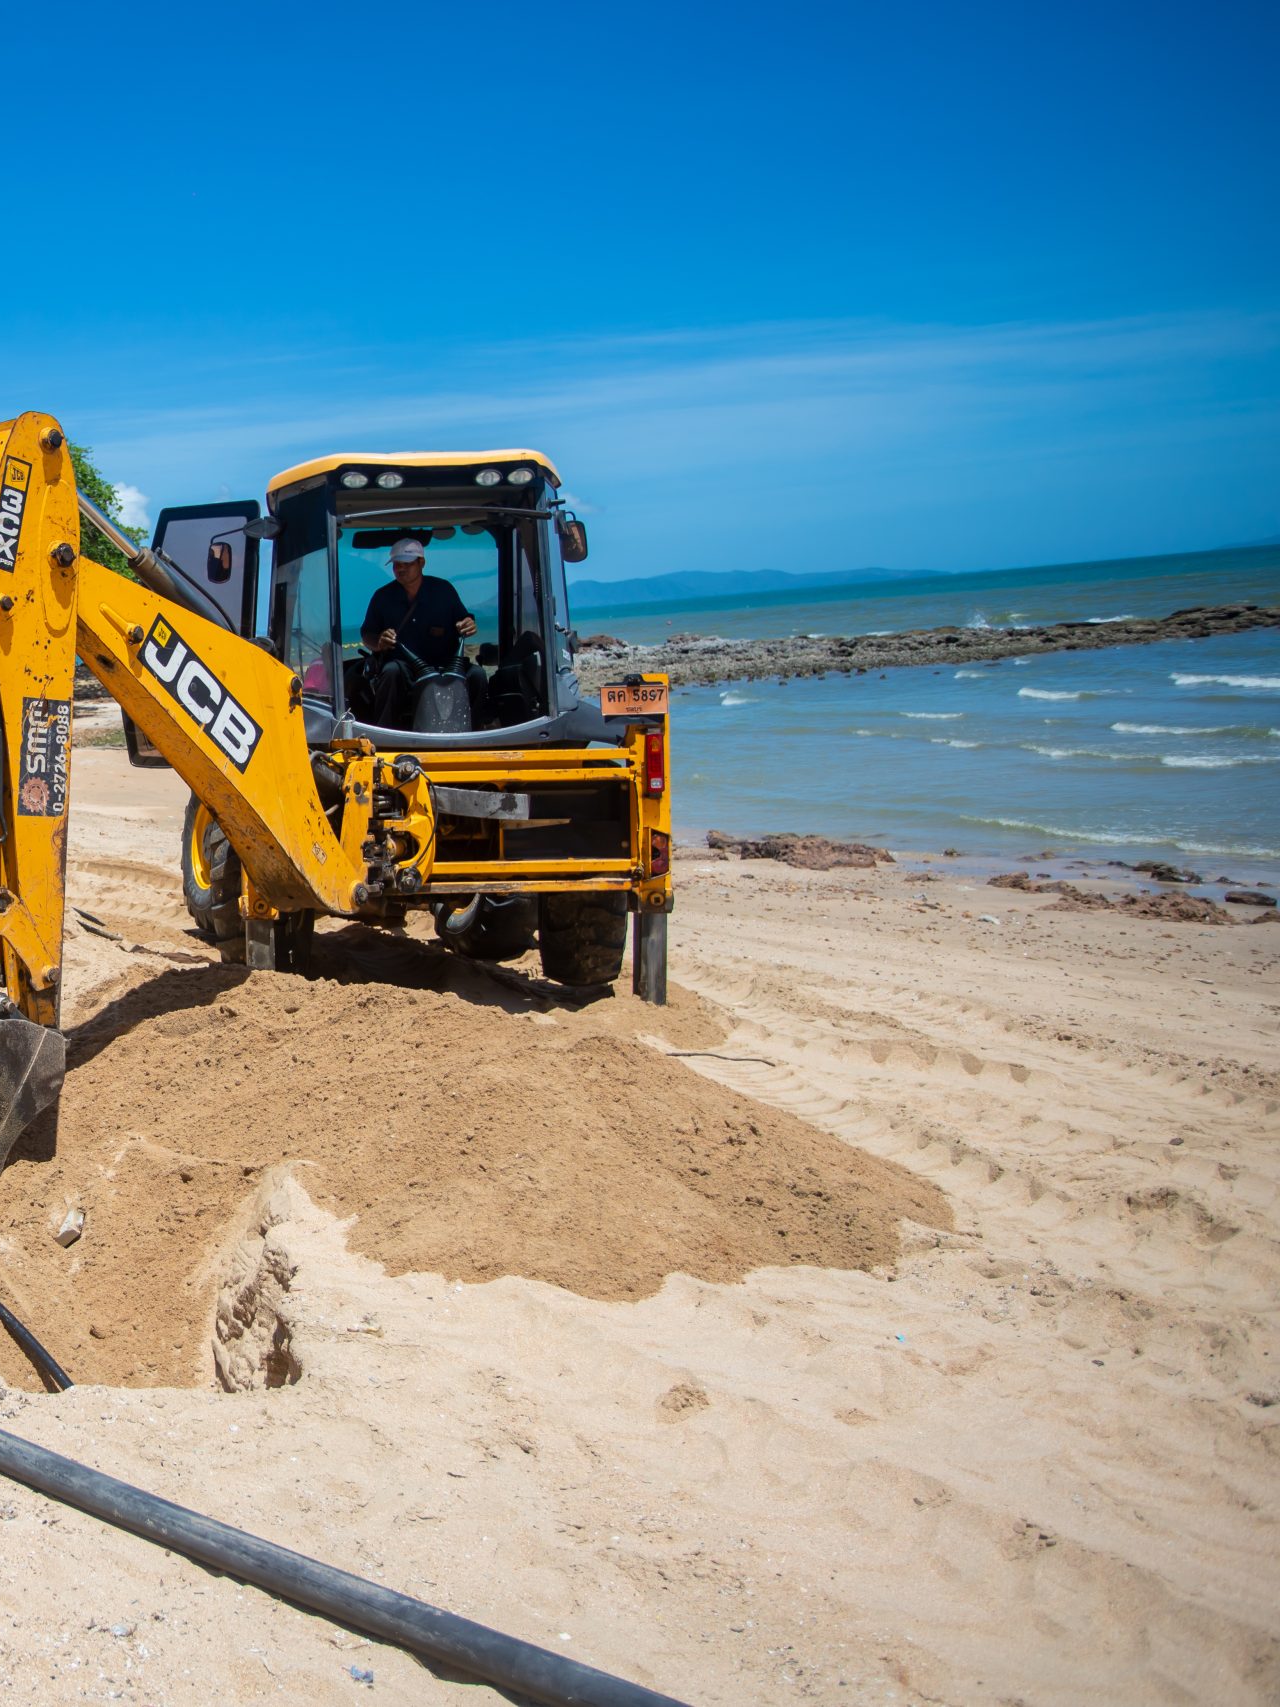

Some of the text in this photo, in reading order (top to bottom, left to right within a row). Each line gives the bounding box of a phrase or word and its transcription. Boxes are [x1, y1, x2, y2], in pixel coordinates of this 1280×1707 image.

[11, 466, 25, 481] JCB
[144, 640, 257, 764] JCB
[632, 689, 664, 702] 5897
[52, 704, 70, 812] 0-2726-8088
